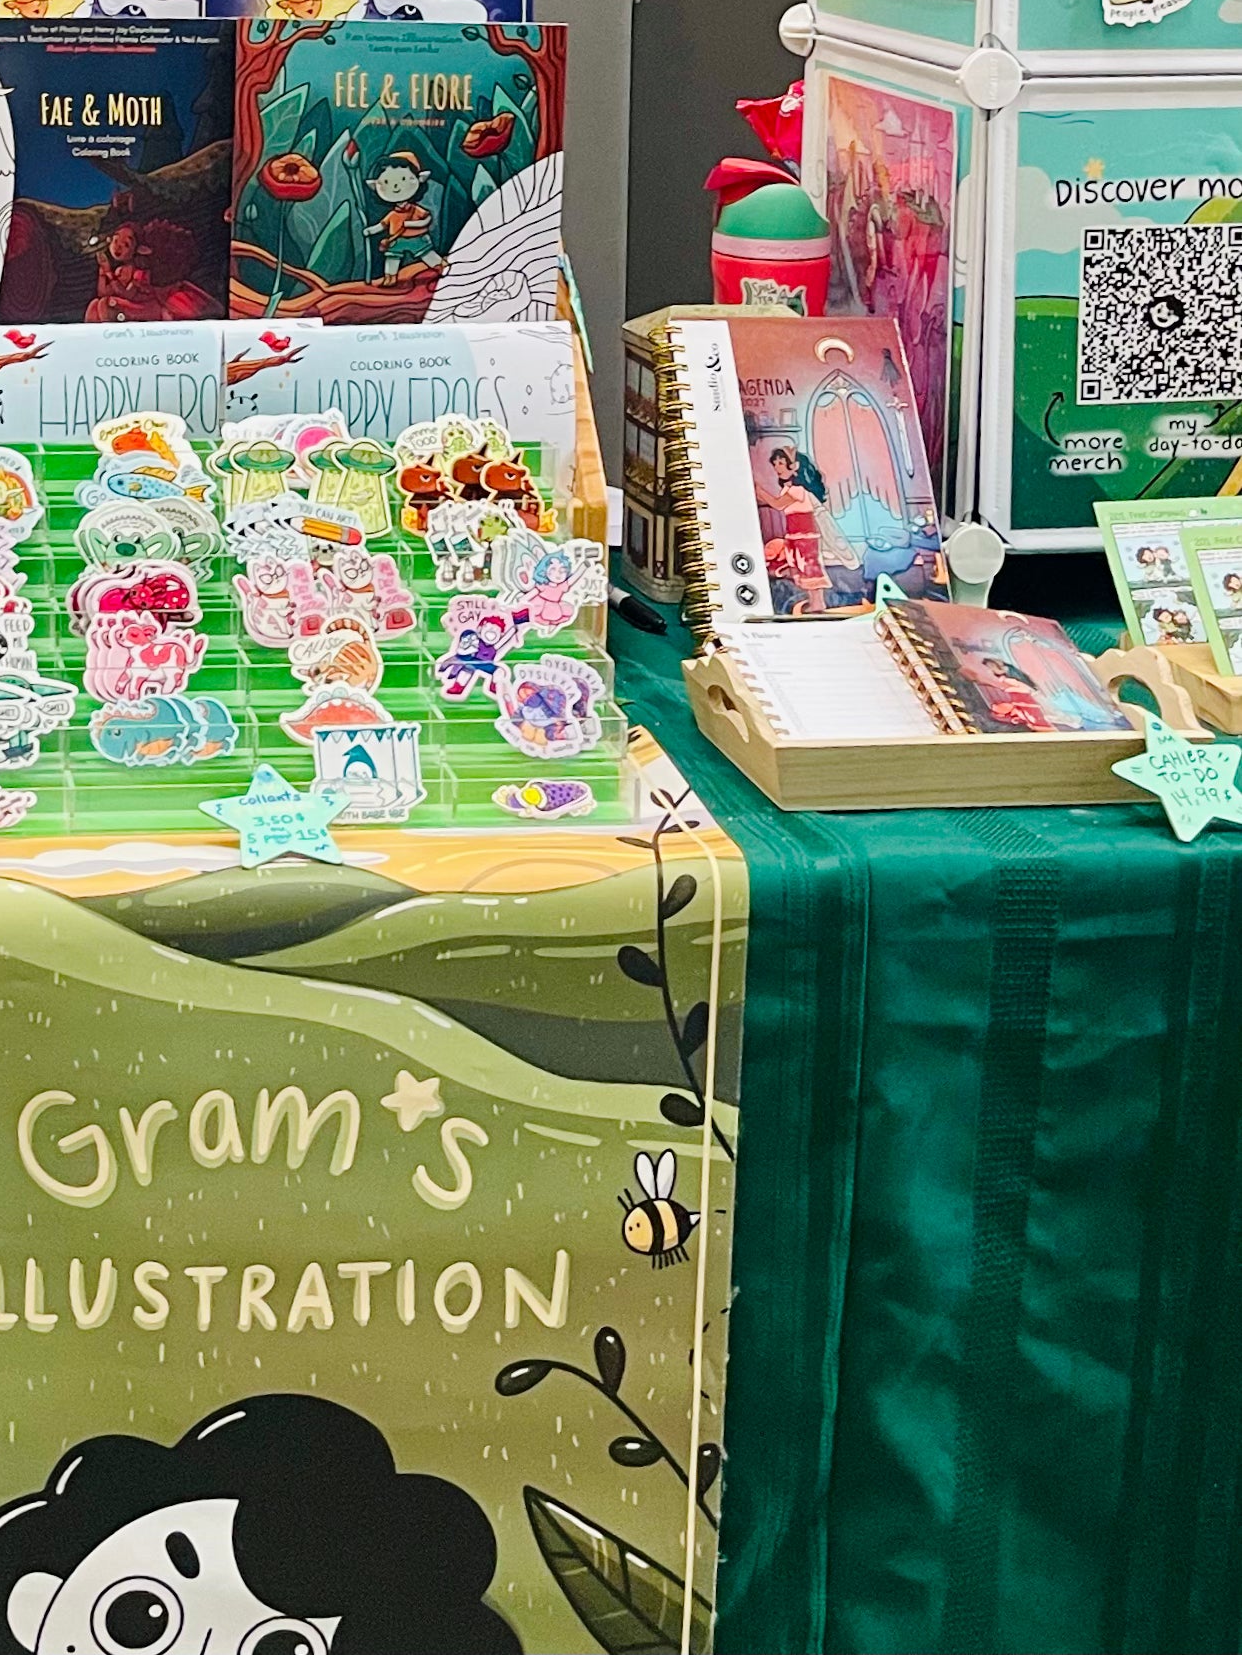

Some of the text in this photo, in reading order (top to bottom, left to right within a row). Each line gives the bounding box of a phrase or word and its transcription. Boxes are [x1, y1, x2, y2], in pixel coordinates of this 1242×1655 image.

[335, 65, 473, 111] FÉE & FLORE
[81, 93, 101, 127] &
[1055, 177, 1186, 207] Discover
[96, 353, 199, 368] COLORING BOOK
[350, 356, 451, 372] COLORING BOOK
[738, 377, 795, 396] AGENDA
[1169, 418, 1197, 434] my
[1064, 434, 1124, 450] more
[1048, 452, 1122, 471] merch
[457, 600, 487, 611] STILL
[458, 611, 481, 623] GAY
[519, 669, 575, 700] DYSLEXIA
[545, 659, 599, 694] DYSLEXIA
[1149, 749, 1212, 770] CAHIER
[1156, 767, 1218, 783] TO-DO
